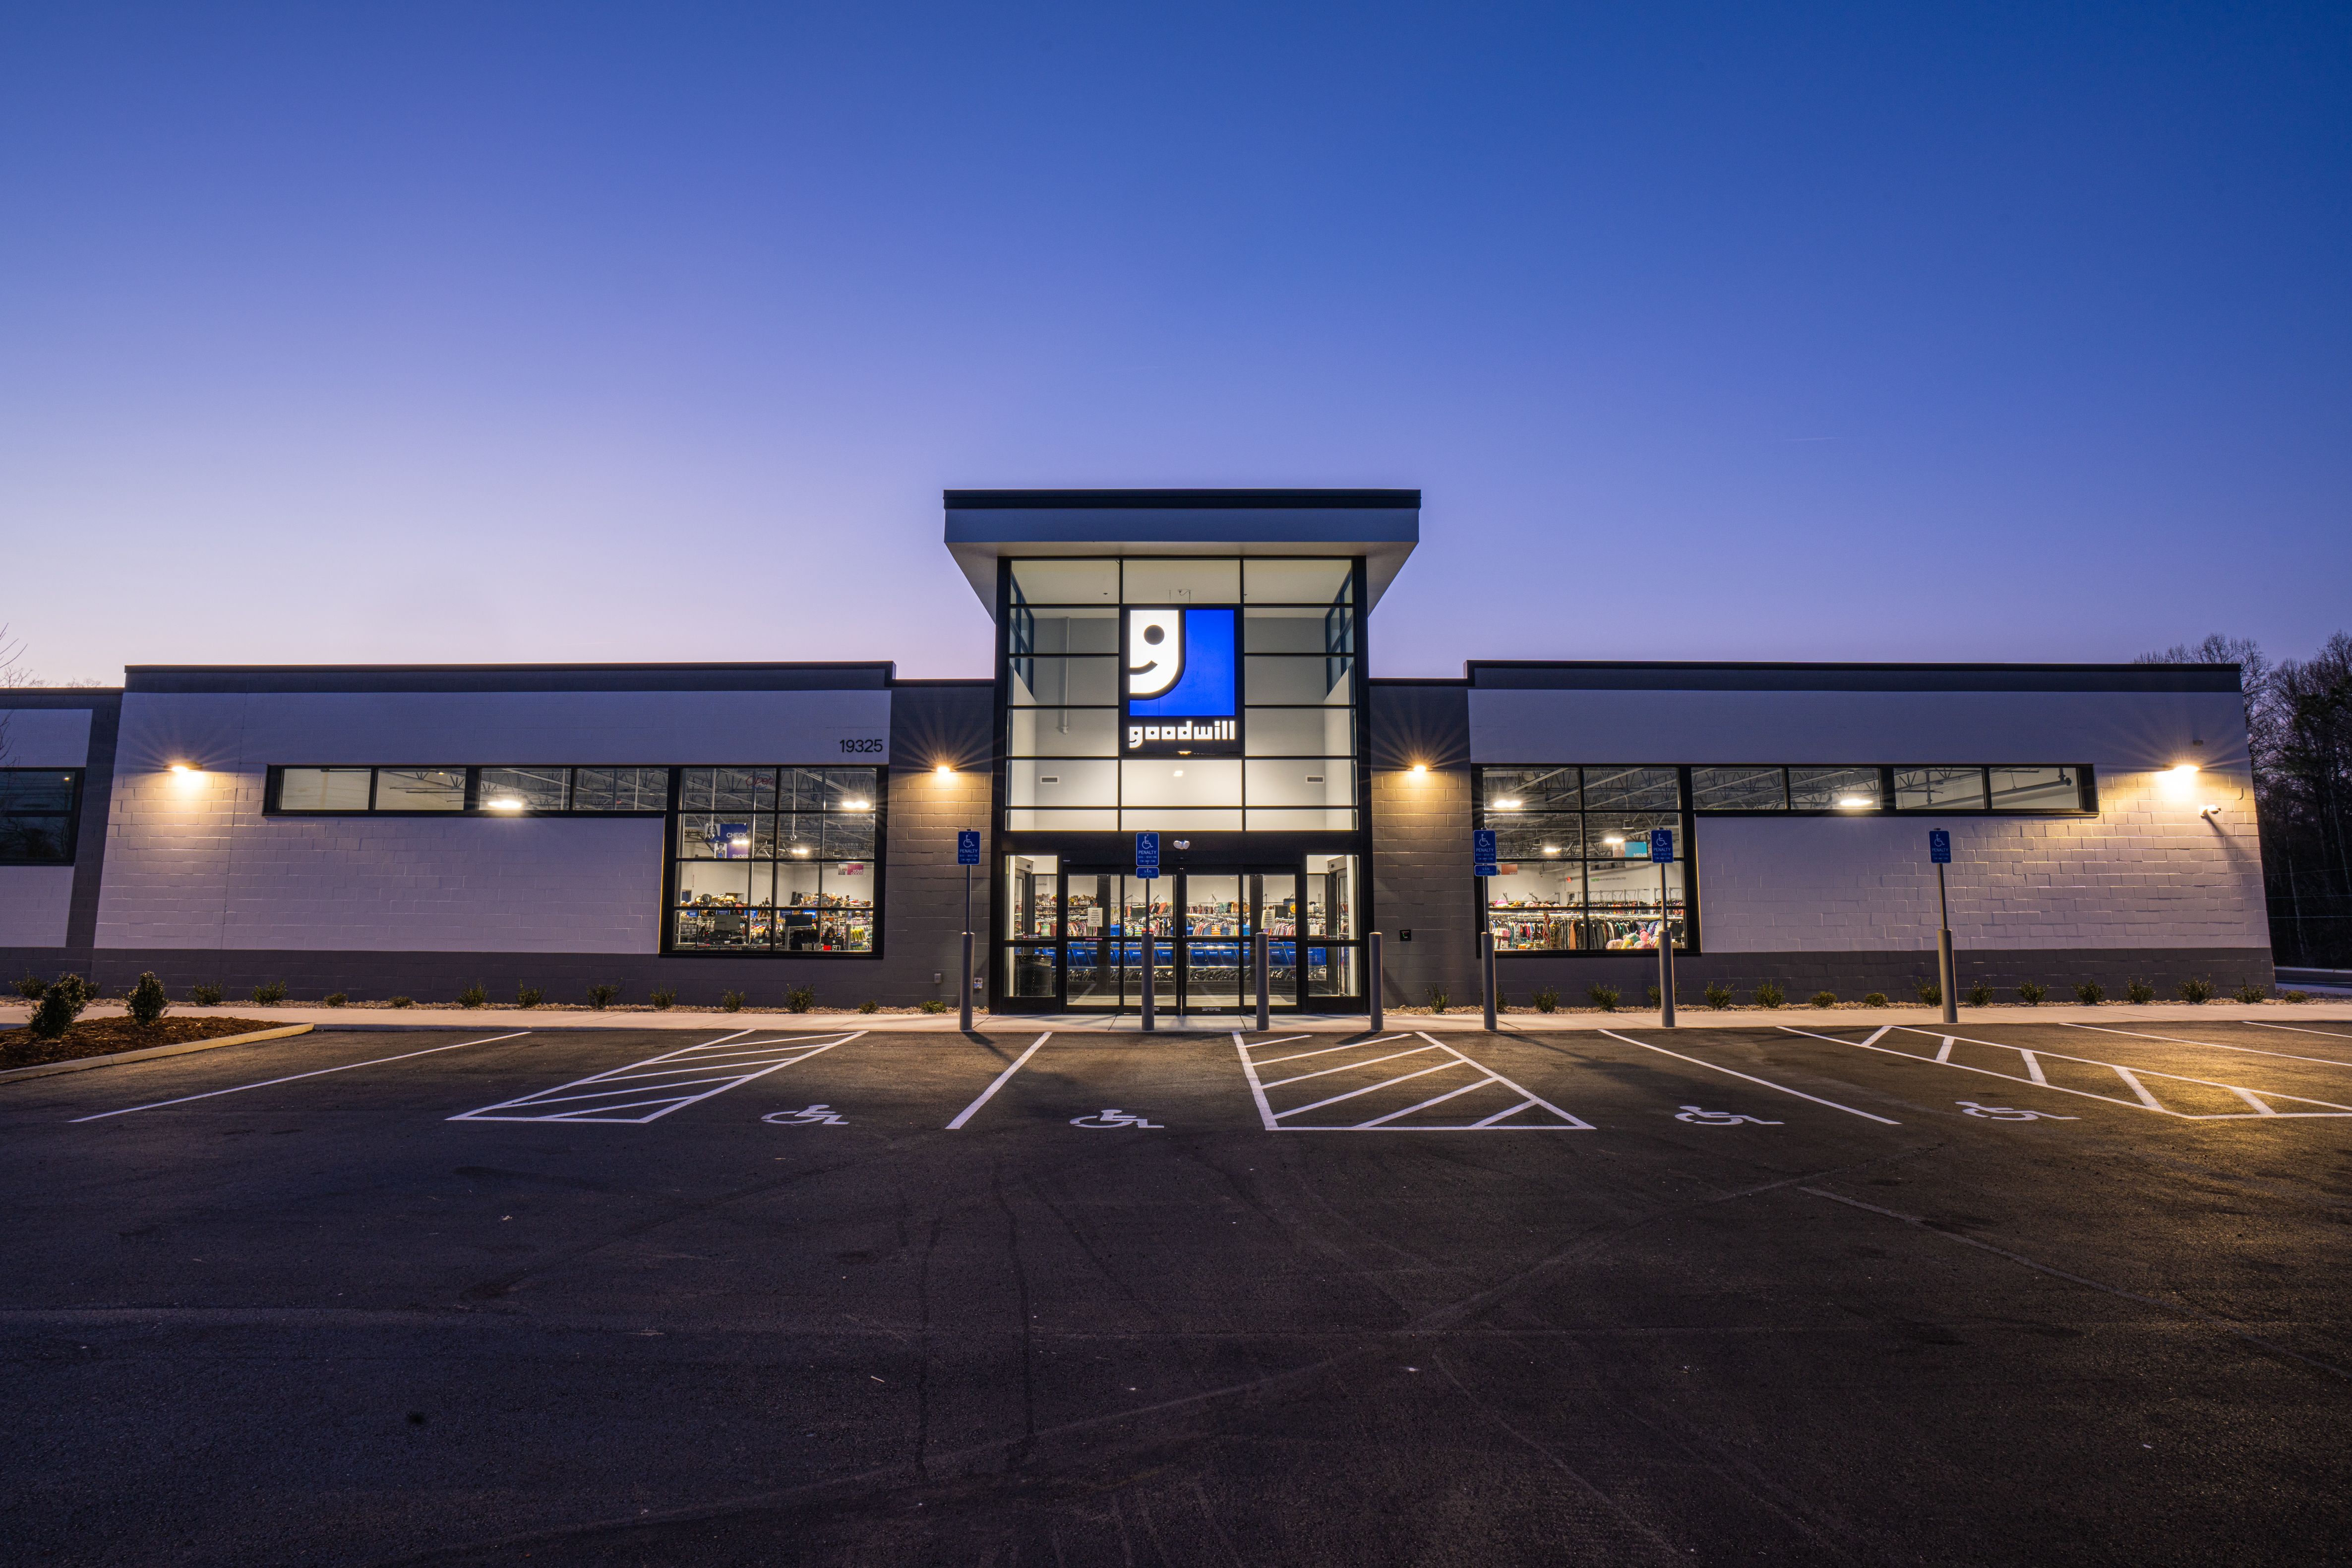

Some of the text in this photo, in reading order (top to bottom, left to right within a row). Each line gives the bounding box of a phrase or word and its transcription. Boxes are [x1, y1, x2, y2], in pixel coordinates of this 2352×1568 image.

[1129, 721, 1235, 748] goodwill
[840, 739, 883, 752] 19325
[746, 775, 774, 787] Open
